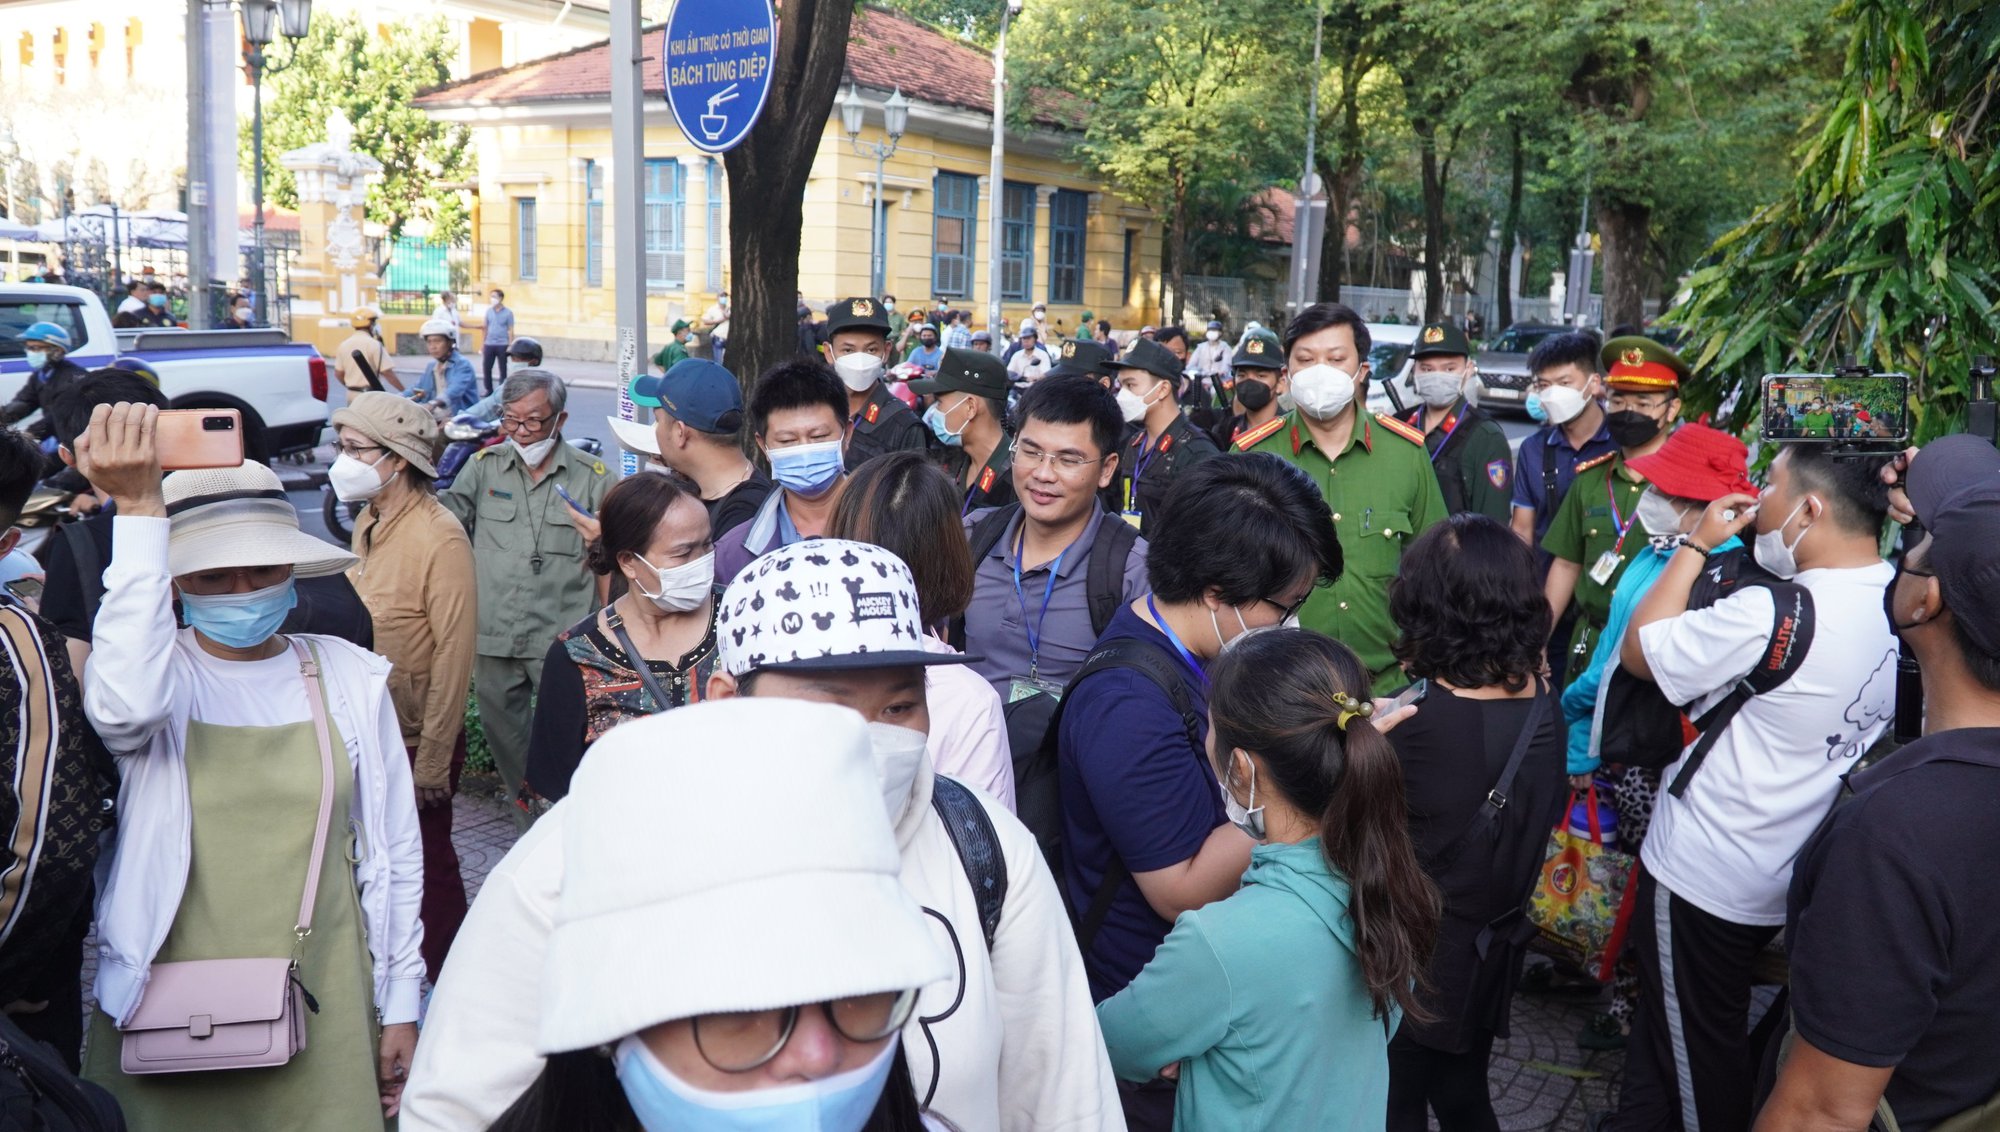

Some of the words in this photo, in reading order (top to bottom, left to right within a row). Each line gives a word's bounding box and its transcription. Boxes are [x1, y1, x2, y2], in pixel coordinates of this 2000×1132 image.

[670, 40, 686, 56] KHU
[687, 30, 698, 54] ẨM
[700, 33, 719, 55] THỰC
[720, 28, 731, 50] CÓ
[733, 25, 750, 47] THỜI
[750, 26, 769, 45] GIAN
[671, 61, 703, 87] BÁCH
[706, 56, 737, 83] TÙNG
[739, 51, 767, 82] DIỆP
[856, 596, 892, 607] MICKEY
[859, 605, 893, 617] MOUSE
[783, 614, 801, 632] M
[1768, 616, 1794, 671] HUFLITer
